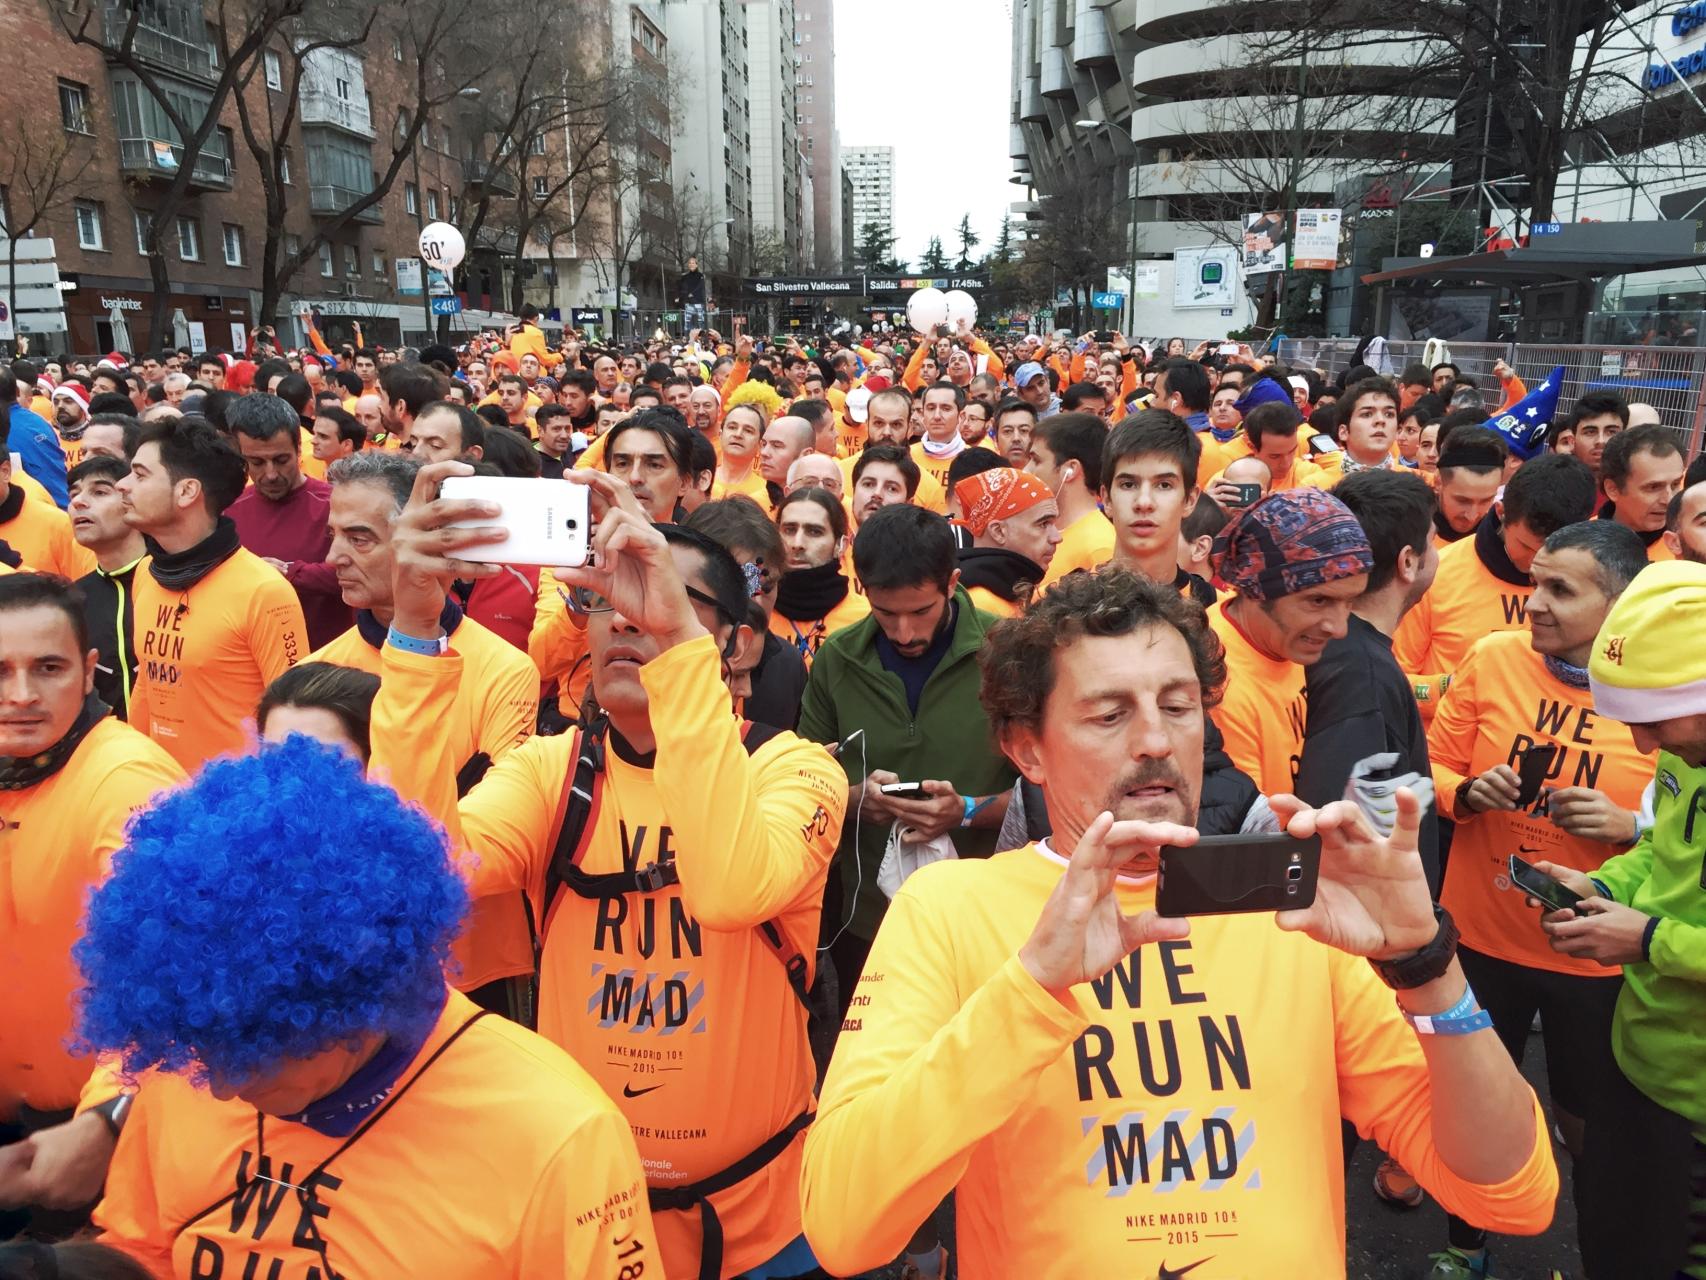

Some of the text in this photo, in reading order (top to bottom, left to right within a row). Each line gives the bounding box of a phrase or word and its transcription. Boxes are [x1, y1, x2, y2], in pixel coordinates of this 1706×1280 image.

[1547, 224, 1560, 233] 150
[755, 281, 850, 292] San Silvestre Vallecana
[870, 280, 898, 289] Salida:
[951, 279, 984, 288] 17.45hs.
[157, 604, 182, 632] WE
[144, 630, 185, 661] RUN
[148, 661, 178, 684] MAD
[1535, 698, 1600, 745] WE
[594, 894, 703, 960] RUN
[1090, 940, 1208, 1011] WE
[601, 973, 688, 1028] MAD
[608, 1044, 627, 1057] NIKE
[629, 1048, 662, 1061] MADRID
[1072, 1014, 1252, 1102] RUN
[633, 1062, 655, 1074] 2015
[654, 1128, 708, 1140] VALLECANA
[1102, 1118, 1239, 1187] MAD
[228, 1150, 344, 1253] WE
[576, 1207, 602, 1227] NIKE
[1126, 1214, 1155, 1228] NIKE
[1160, 1211, 1208, 1226] MADRID
[1167, 1230, 1199, 1245] 2015
